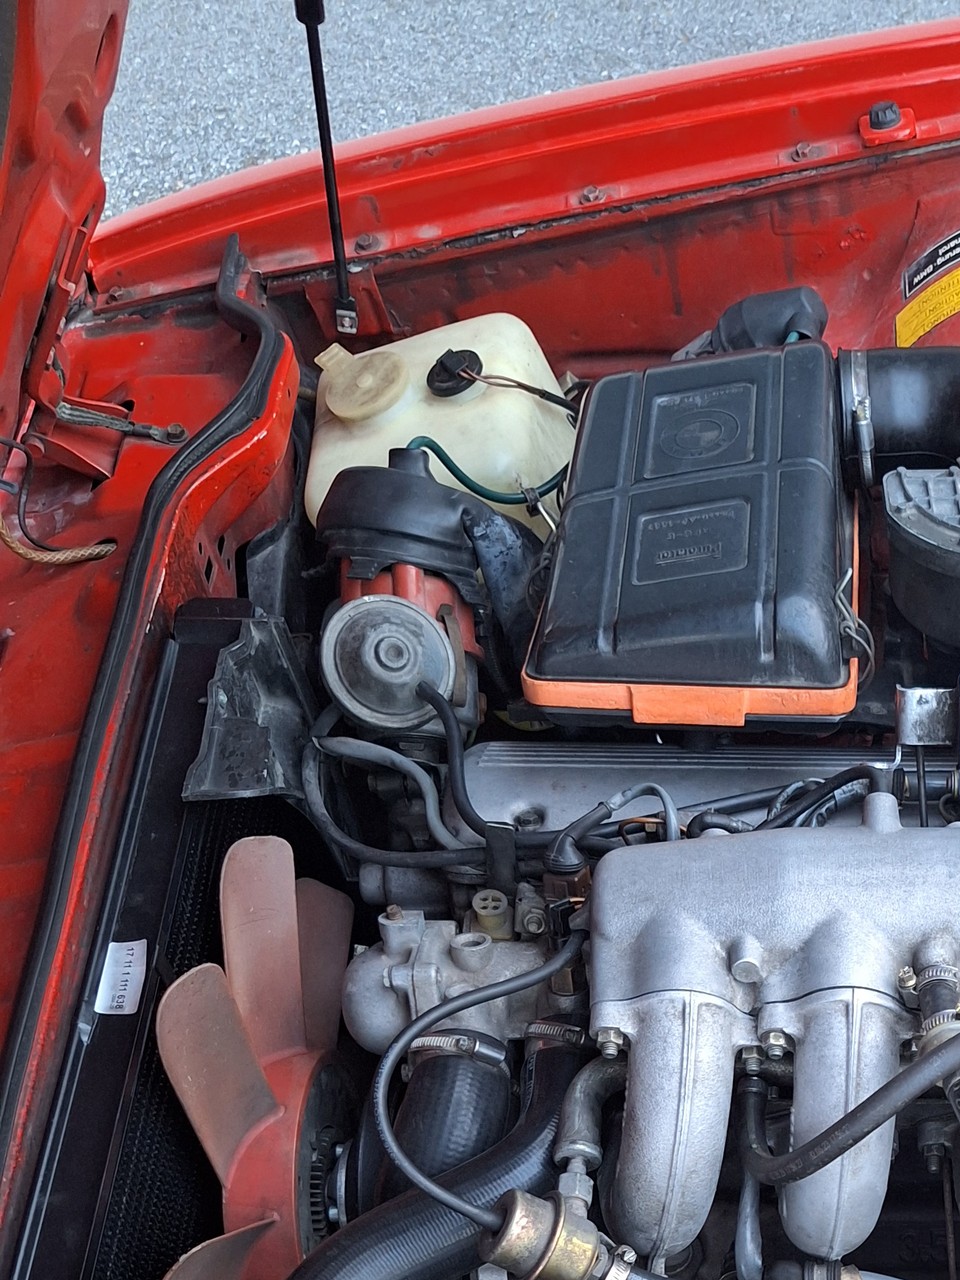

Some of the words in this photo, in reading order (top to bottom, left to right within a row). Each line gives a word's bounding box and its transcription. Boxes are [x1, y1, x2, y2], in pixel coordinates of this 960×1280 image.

[912, 264, 934, 286] BMW
[126, 947, 135, 957] 17
[123, 960, 133, 968] 11
[118, 979, 129, 992] 111
[114, 994, 126, 1009] 638
